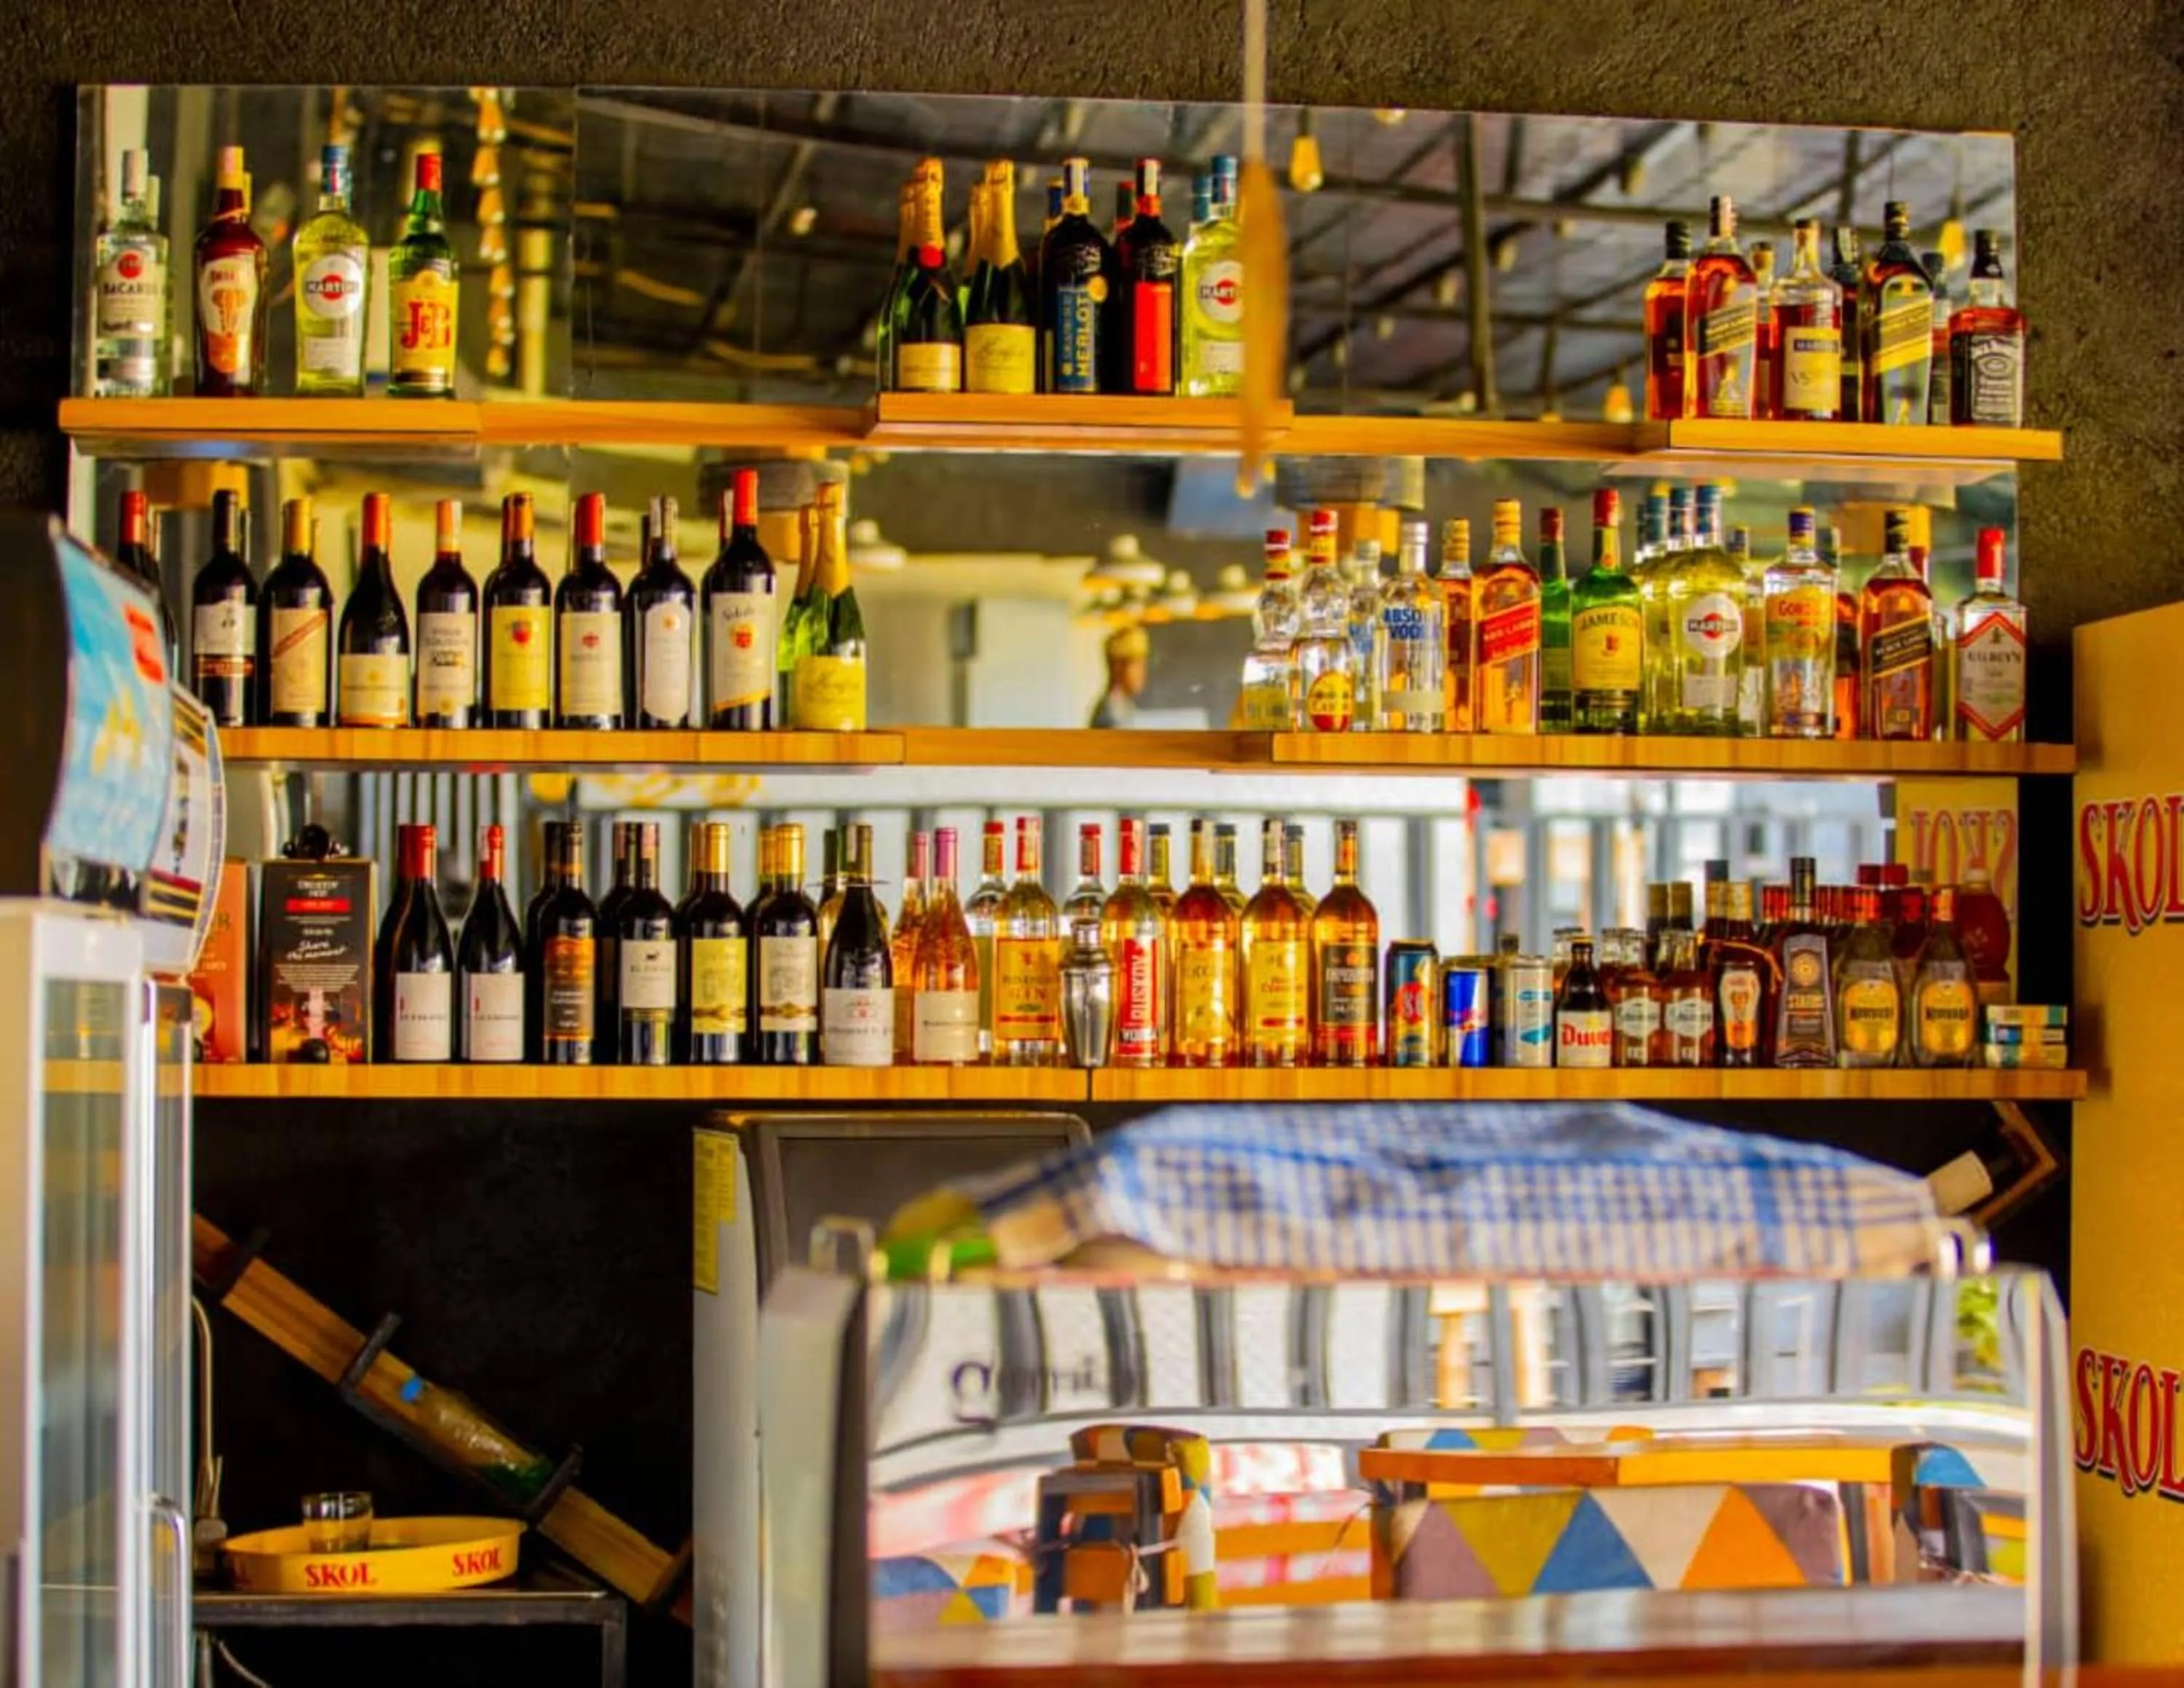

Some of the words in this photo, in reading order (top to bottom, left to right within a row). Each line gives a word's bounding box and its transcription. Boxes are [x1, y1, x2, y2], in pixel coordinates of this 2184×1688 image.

[1076, 295, 1092, 376] MERLOT
[1382, 608, 1422, 623] ABSO
[1389, 624, 1424, 639] VOD
[1561, 1024, 1612, 1047] Duve
[453, 1547, 503, 1576] SKOL
[304, 1562, 377, 1586] SKOL
